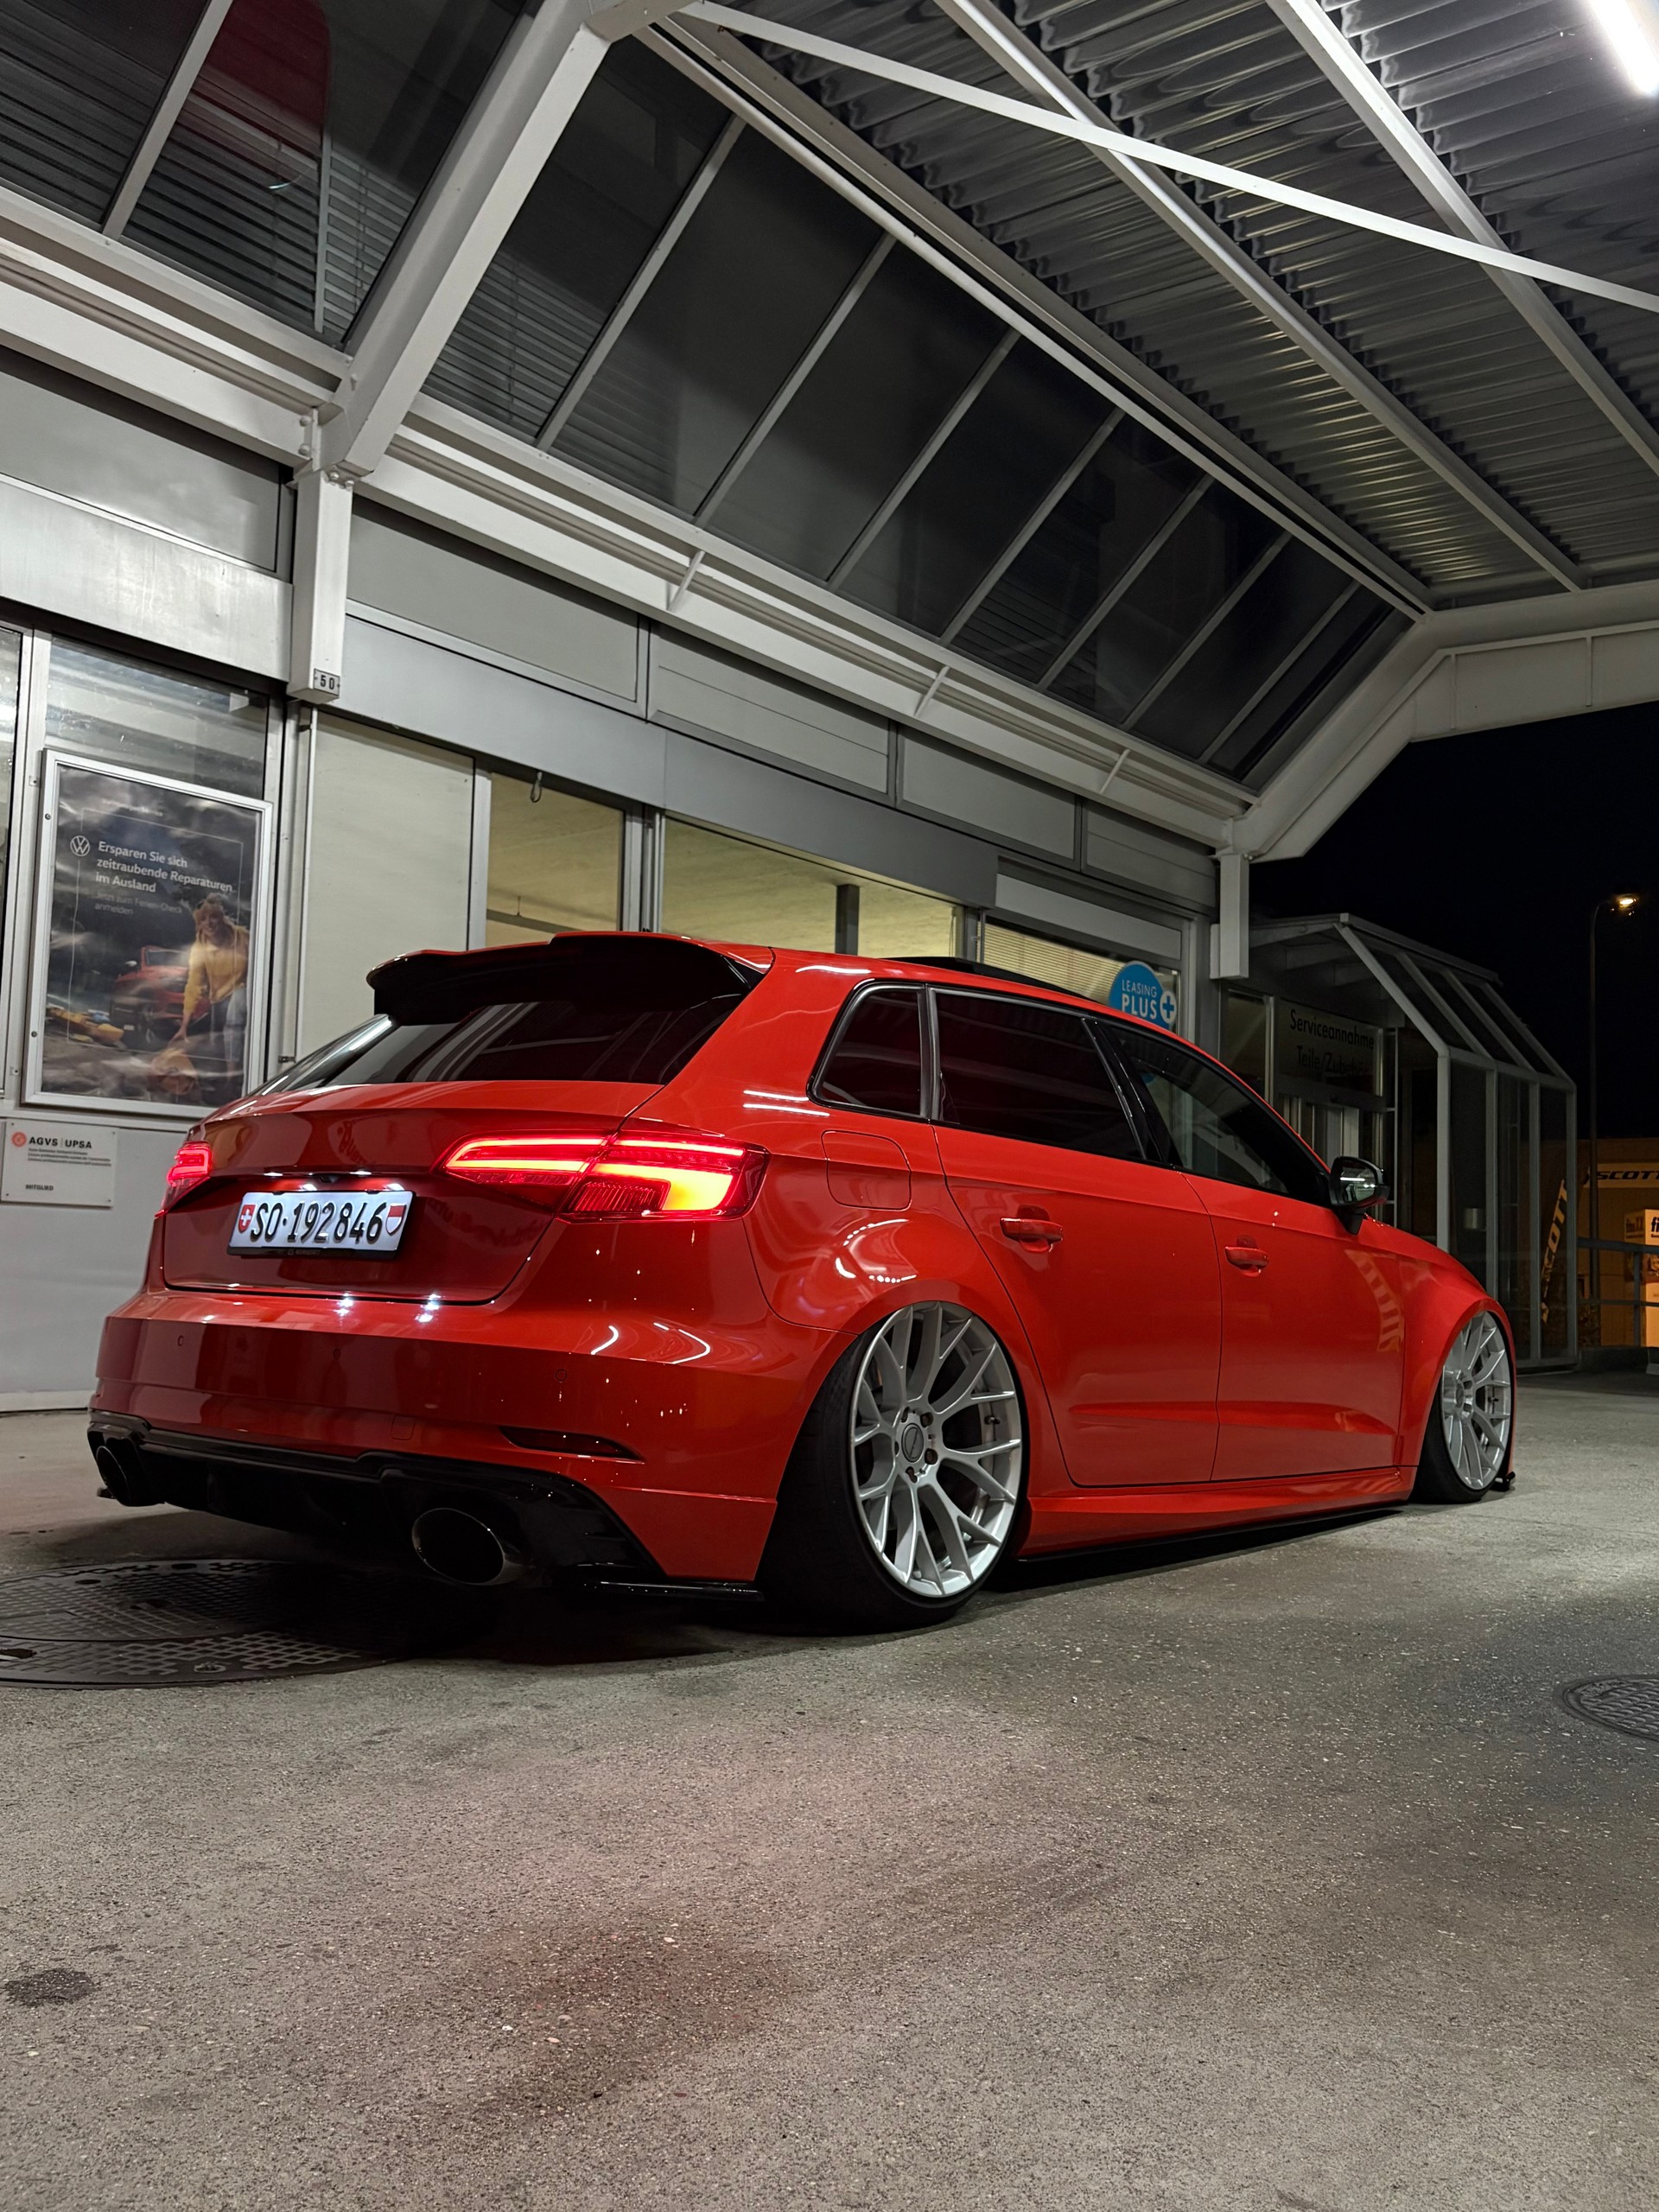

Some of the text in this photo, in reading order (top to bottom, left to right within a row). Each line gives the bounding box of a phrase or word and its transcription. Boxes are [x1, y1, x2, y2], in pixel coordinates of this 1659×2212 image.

[321, 675, 334, 690] 50
[98, 841, 188, 868] Ersparen Sie sich
[96, 873, 156, 893] im Ausland
[97, 858, 233, 893] zeitraubende Reparaturen
[1122, 979, 1157, 998] LEASING
[1122, 993, 1157, 1020] PLUS
[1290, 1009, 1374, 1050] Serviceannahme
[29, 1136, 92, 1149] AGVS UPSA
